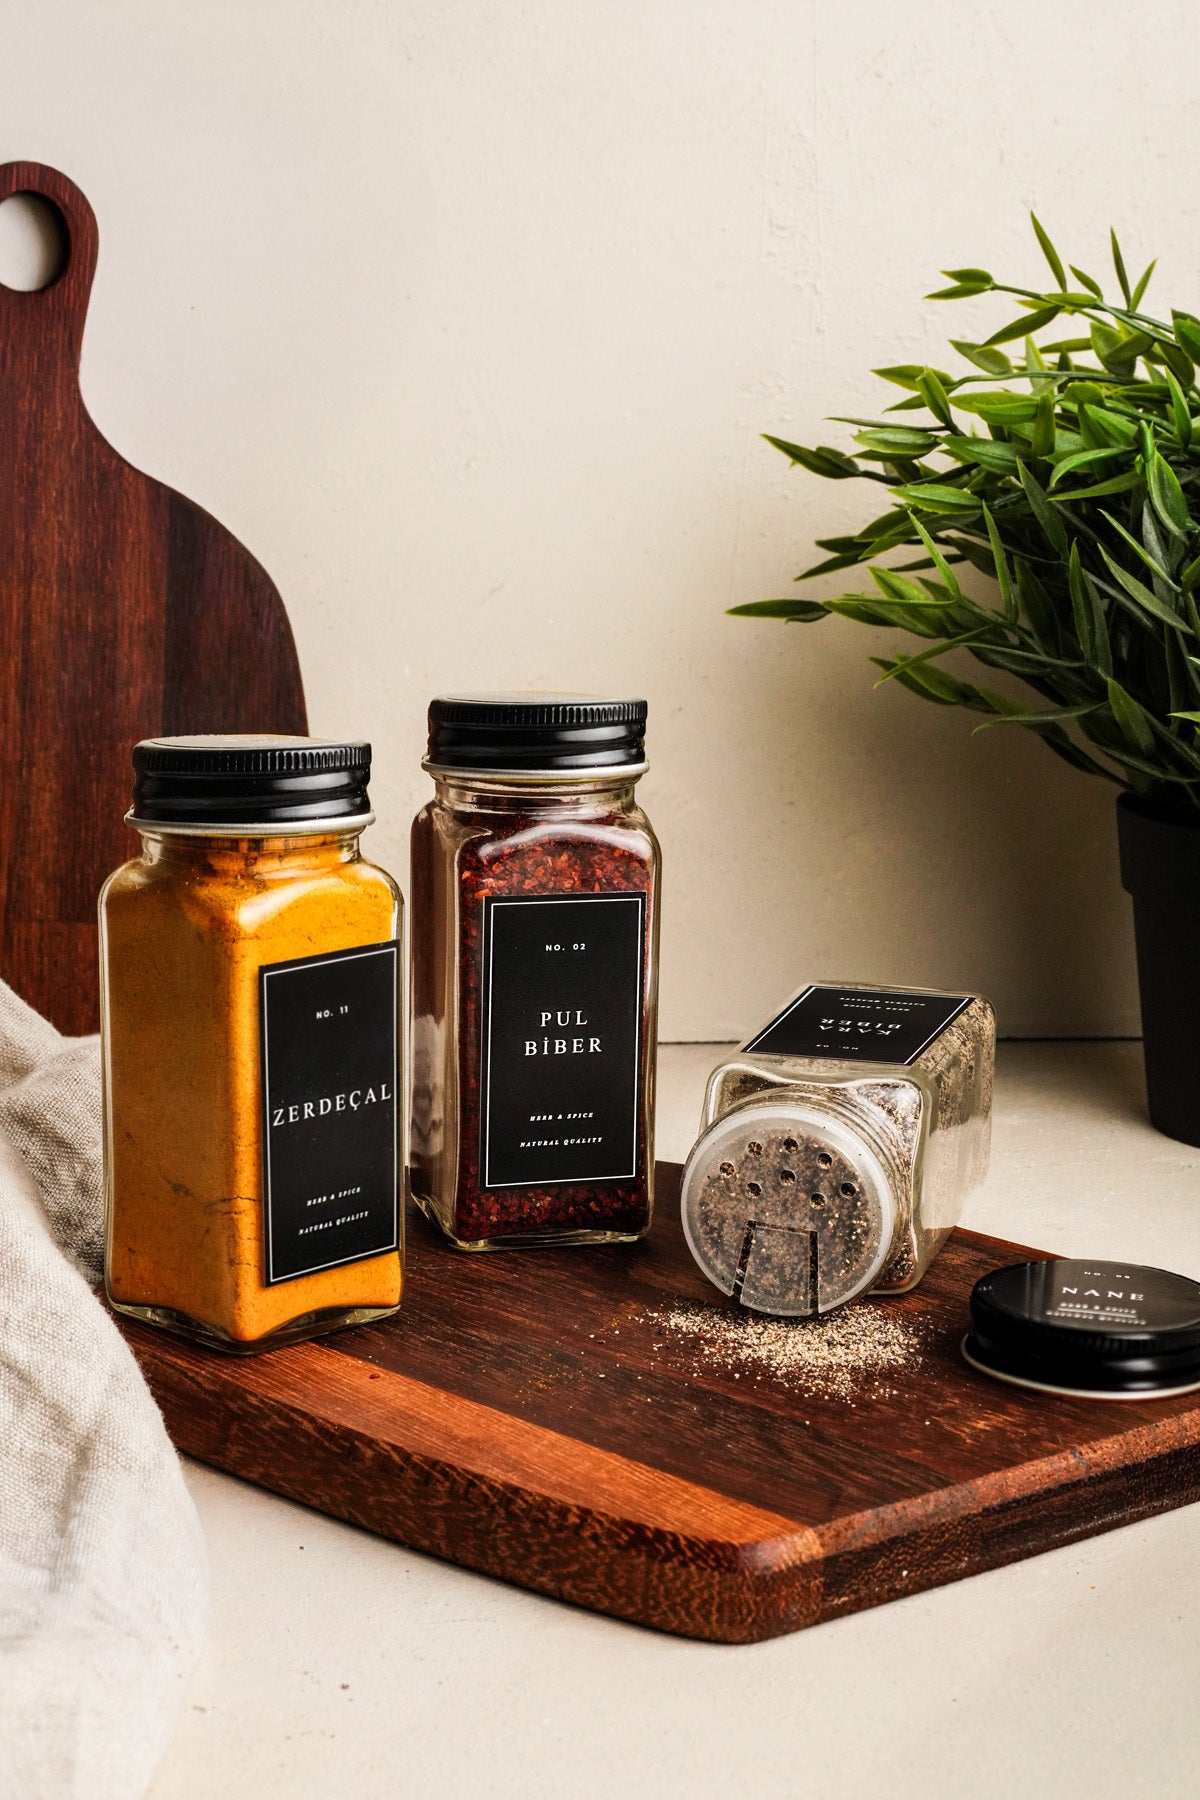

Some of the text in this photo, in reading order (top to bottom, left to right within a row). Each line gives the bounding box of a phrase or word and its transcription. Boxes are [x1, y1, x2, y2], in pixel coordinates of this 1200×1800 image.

[316, 1005, 348, 1020] NO. 11
[540, 1010, 588, 1027] PUL
[819, 1025, 892, 1035] KARA
[524, 1037, 602, 1056] BİBER
[272, 1084, 391, 1126] ZERDEÇAL
[529, 1114, 553, 1122] HERB
[566, 1112, 594, 1120] SPICE
[519, 1136, 603, 1148] NATURAL QUALITY
[338, 1186, 361, 1198] SPICE
[298, 1210, 369, 1236] NATURAL QUALITY
[1061, 1286, 1144, 1301] NANE
